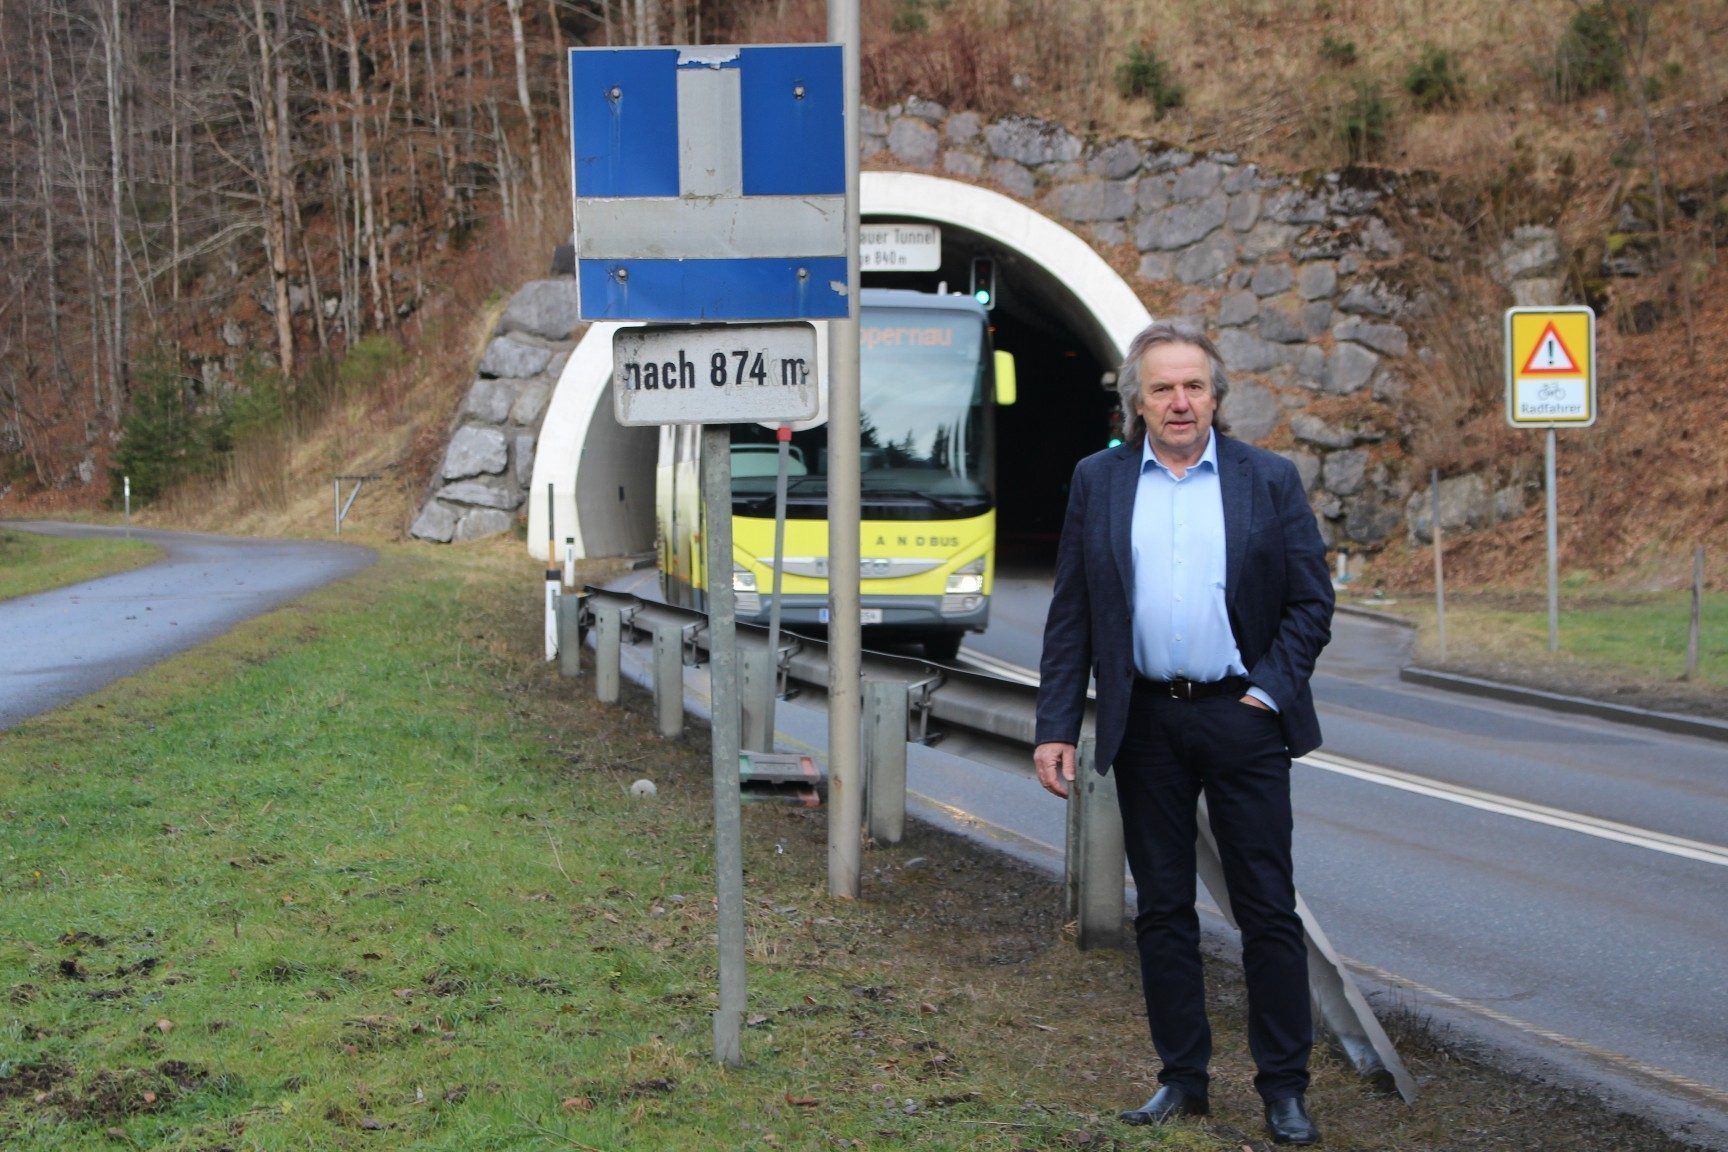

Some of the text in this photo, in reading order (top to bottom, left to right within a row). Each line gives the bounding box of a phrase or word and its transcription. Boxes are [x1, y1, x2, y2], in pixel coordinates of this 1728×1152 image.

[860, 228, 936, 245] auer Tunnel
[860, 326, 953, 350] pernau
[625, 350, 807, 390] nach 874 m
[1521, 403, 1581, 414] Radfahrer
[861, 535, 959, 547] ANDBUS
